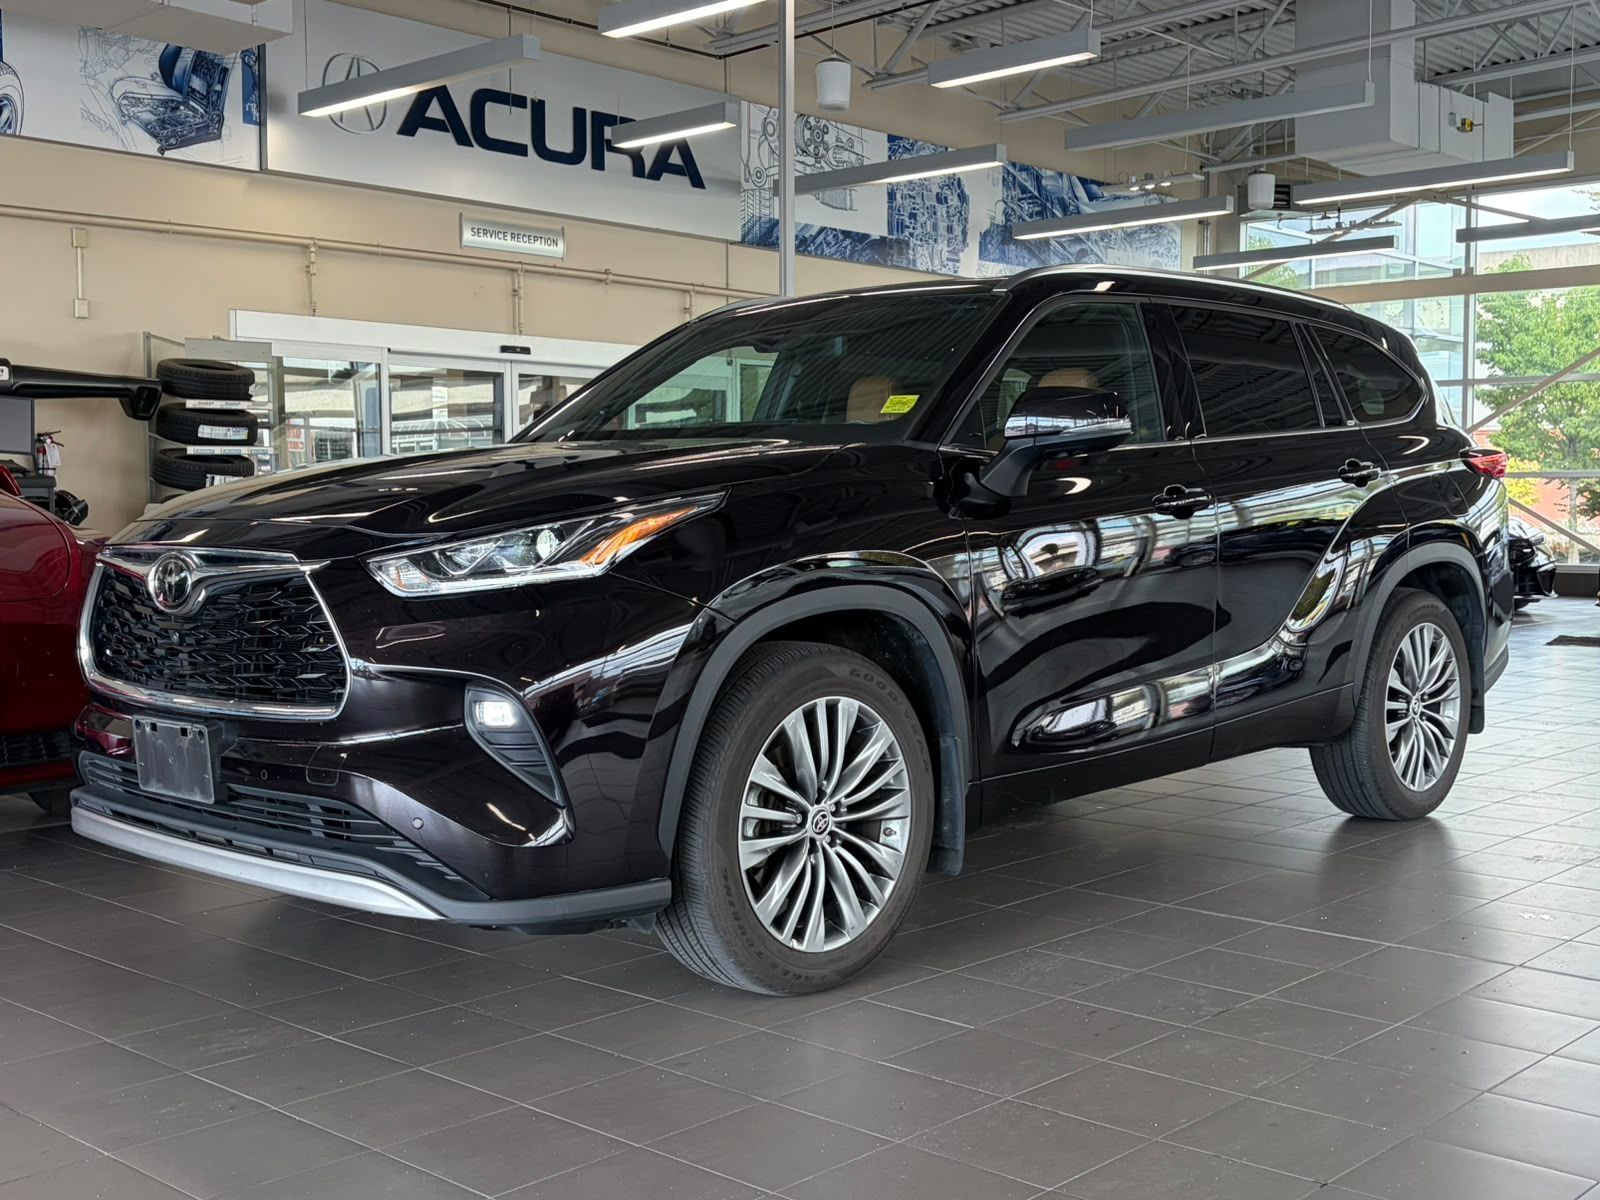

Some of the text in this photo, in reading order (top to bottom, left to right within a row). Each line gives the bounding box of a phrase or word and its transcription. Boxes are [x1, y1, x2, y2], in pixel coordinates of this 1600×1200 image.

[396, 84, 706, 190] ACURA
[470, 226, 559, 248] SERVICE RECEPTION
